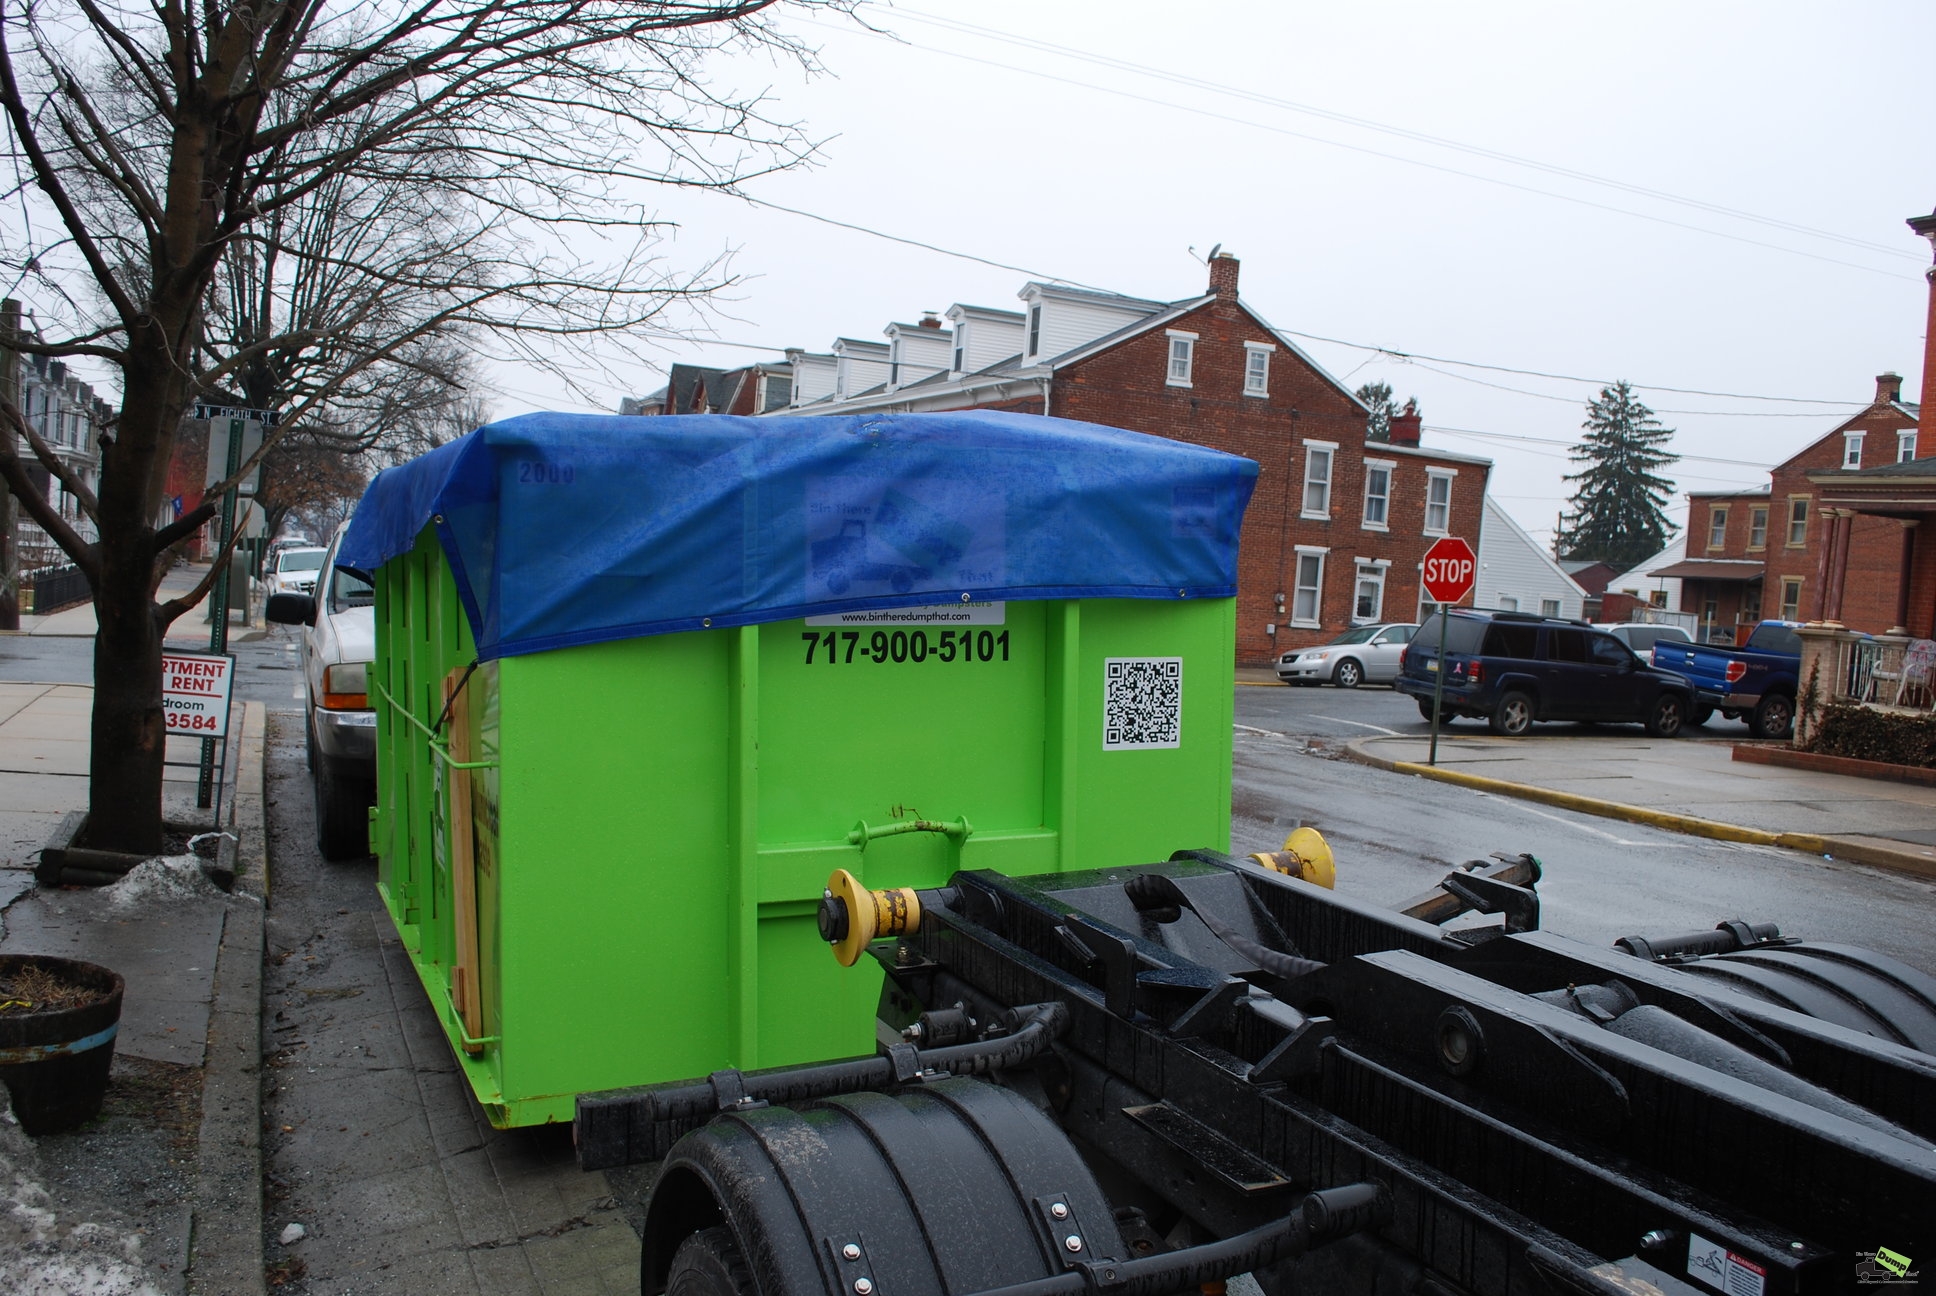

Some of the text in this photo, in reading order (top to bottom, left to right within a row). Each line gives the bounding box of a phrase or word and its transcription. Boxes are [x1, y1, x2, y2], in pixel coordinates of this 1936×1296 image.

[204, 406, 211, 420] N
[220, 407, 251, 420] EIGHTH
[1426, 558, 1472, 583] STOP
[842, 612, 970, 623] www.bintheredumpthat.com
[802, 630, 1009, 665] 717-900-5101
[171, 676, 214, 692] RENT
[166, 713, 216, 731] 3584
[1736, 1256, 1762, 1273] DANGER
